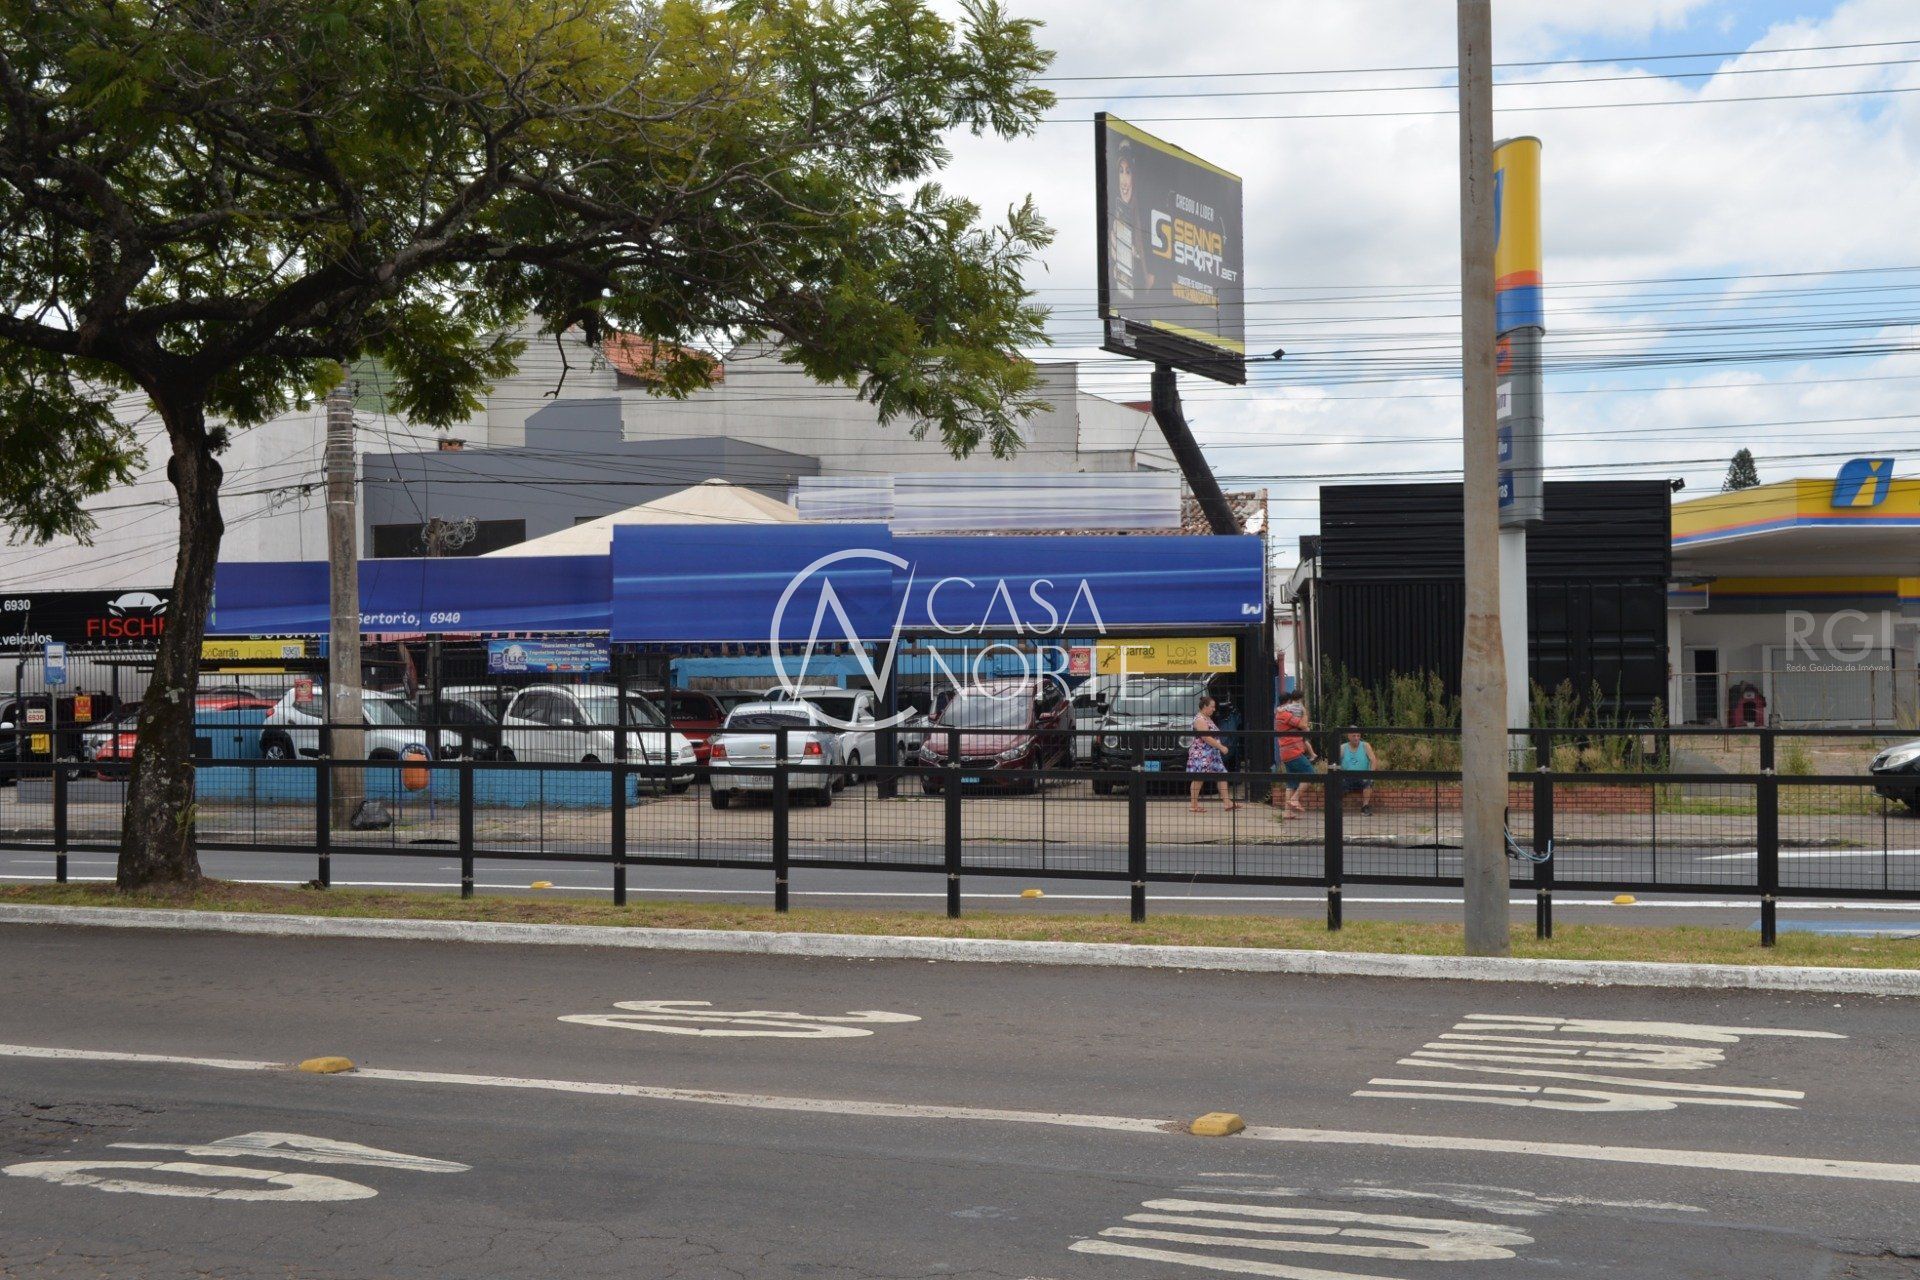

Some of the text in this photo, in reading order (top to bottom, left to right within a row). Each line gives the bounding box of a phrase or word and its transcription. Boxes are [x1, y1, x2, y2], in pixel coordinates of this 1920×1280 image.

[1173, 218, 1223, 257] SENNA
[4, 599, 31, 611] 6930
[429, 612, 461, 624] 6940
[1166, 644, 1197, 659] Loja
